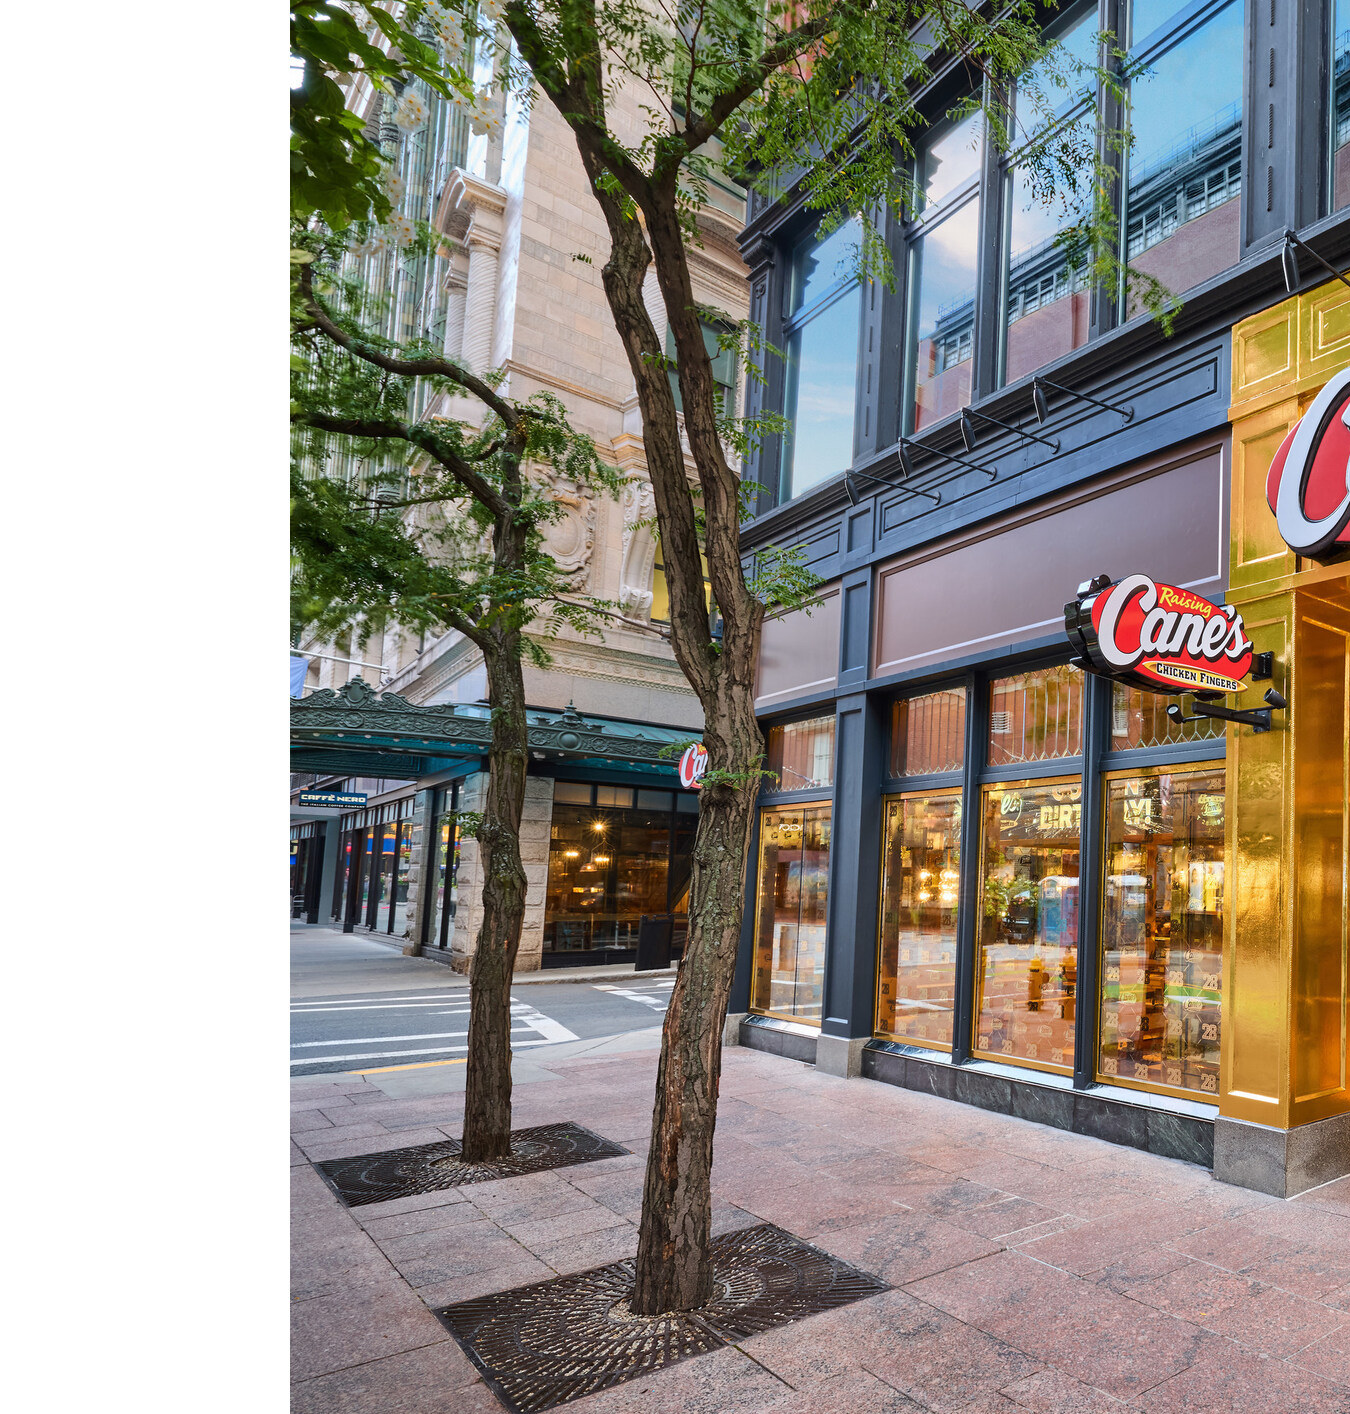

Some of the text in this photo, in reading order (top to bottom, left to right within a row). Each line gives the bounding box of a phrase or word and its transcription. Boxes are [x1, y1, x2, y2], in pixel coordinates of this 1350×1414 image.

[1159, 586, 1212, 618] Raising
[1099, 573, 1253, 666] Cane's
[1156, 662, 1237, 690] CHICKEN FINGERS
[1169, 970, 1184, 986] 28
[1202, 974, 1218, 991] 28
[1201, 1023, 1217, 1041] 28
[1104, 1057, 1118, 1074] 28
[1134, 1062, 1148, 1080] 28
[1167, 1068, 1182, 1085] 28
[1200, 1073, 1217, 1091] 28
